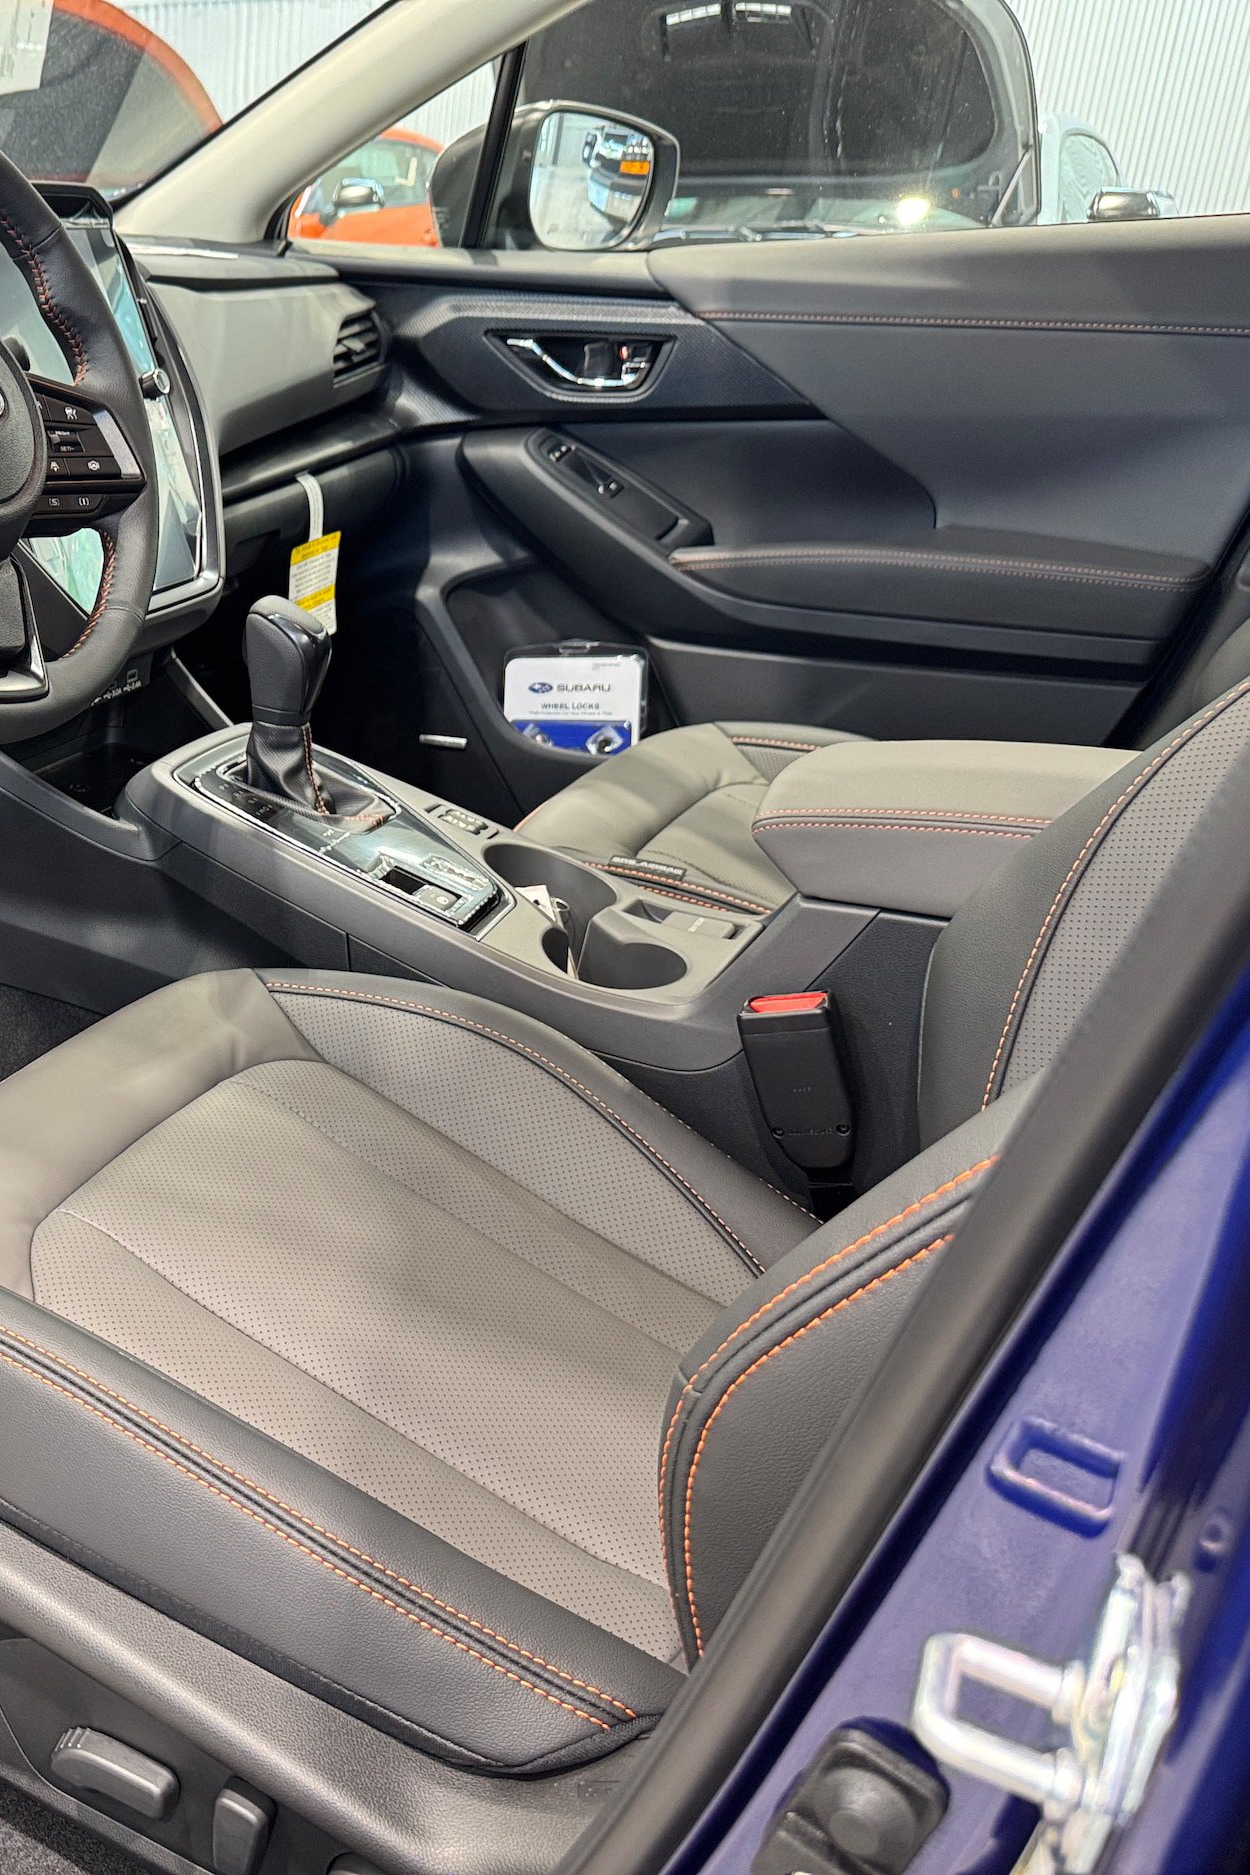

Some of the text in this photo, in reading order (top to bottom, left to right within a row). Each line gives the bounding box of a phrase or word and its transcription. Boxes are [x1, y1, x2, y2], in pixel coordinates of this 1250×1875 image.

[556, 683, 612, 693] SUBARU
[541, 702, 600, 711] WHEEL LOCKS
